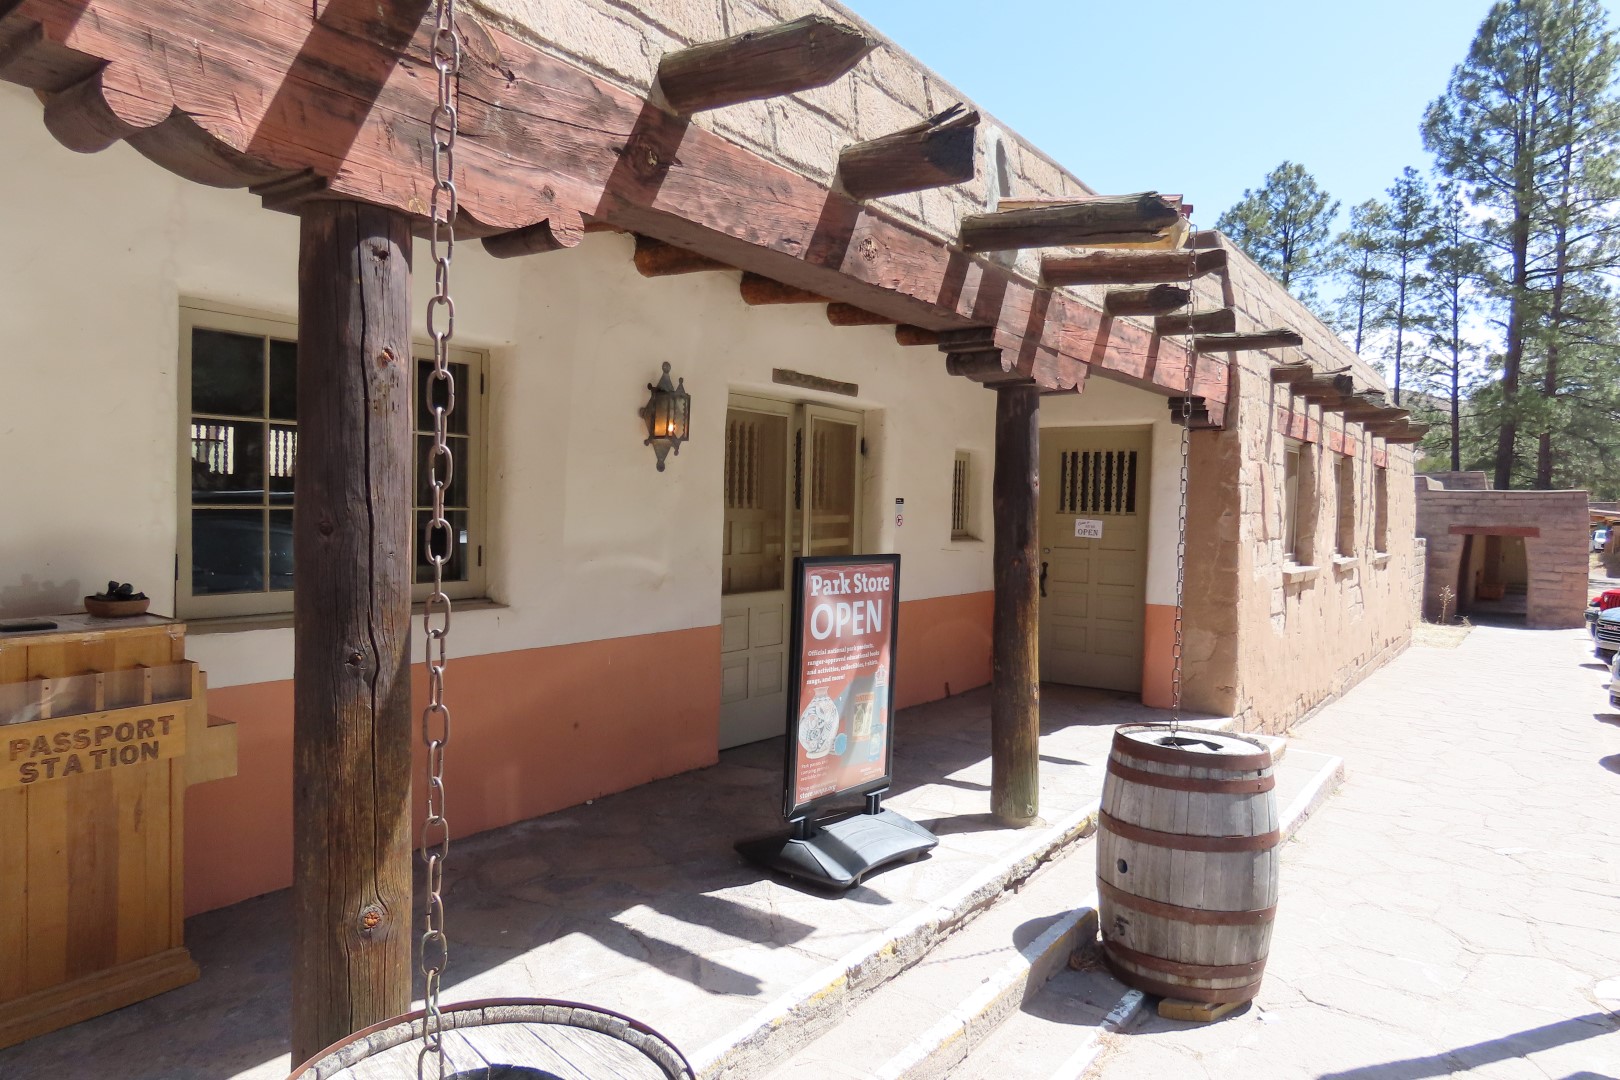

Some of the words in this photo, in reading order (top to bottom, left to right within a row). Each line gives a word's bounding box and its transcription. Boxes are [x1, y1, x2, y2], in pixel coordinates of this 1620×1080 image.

[811, 573, 851, 596] Park
[853, 573, 890, 594] Store
[811, 599, 882, 640] OPEN
[807, 657, 846, 666] ranger-approved
[846, 652, 869, 661] educational
[808, 649, 826, 657] Official
[827, 647, 846, 655] national
[847, 645, 856, 653] park
[817, 666, 840, 674] activities,
[840, 662, 865, 671] collectibles,
[9, 715, 174, 761] PASSPORT
[19, 741, 159, 783] STATION
